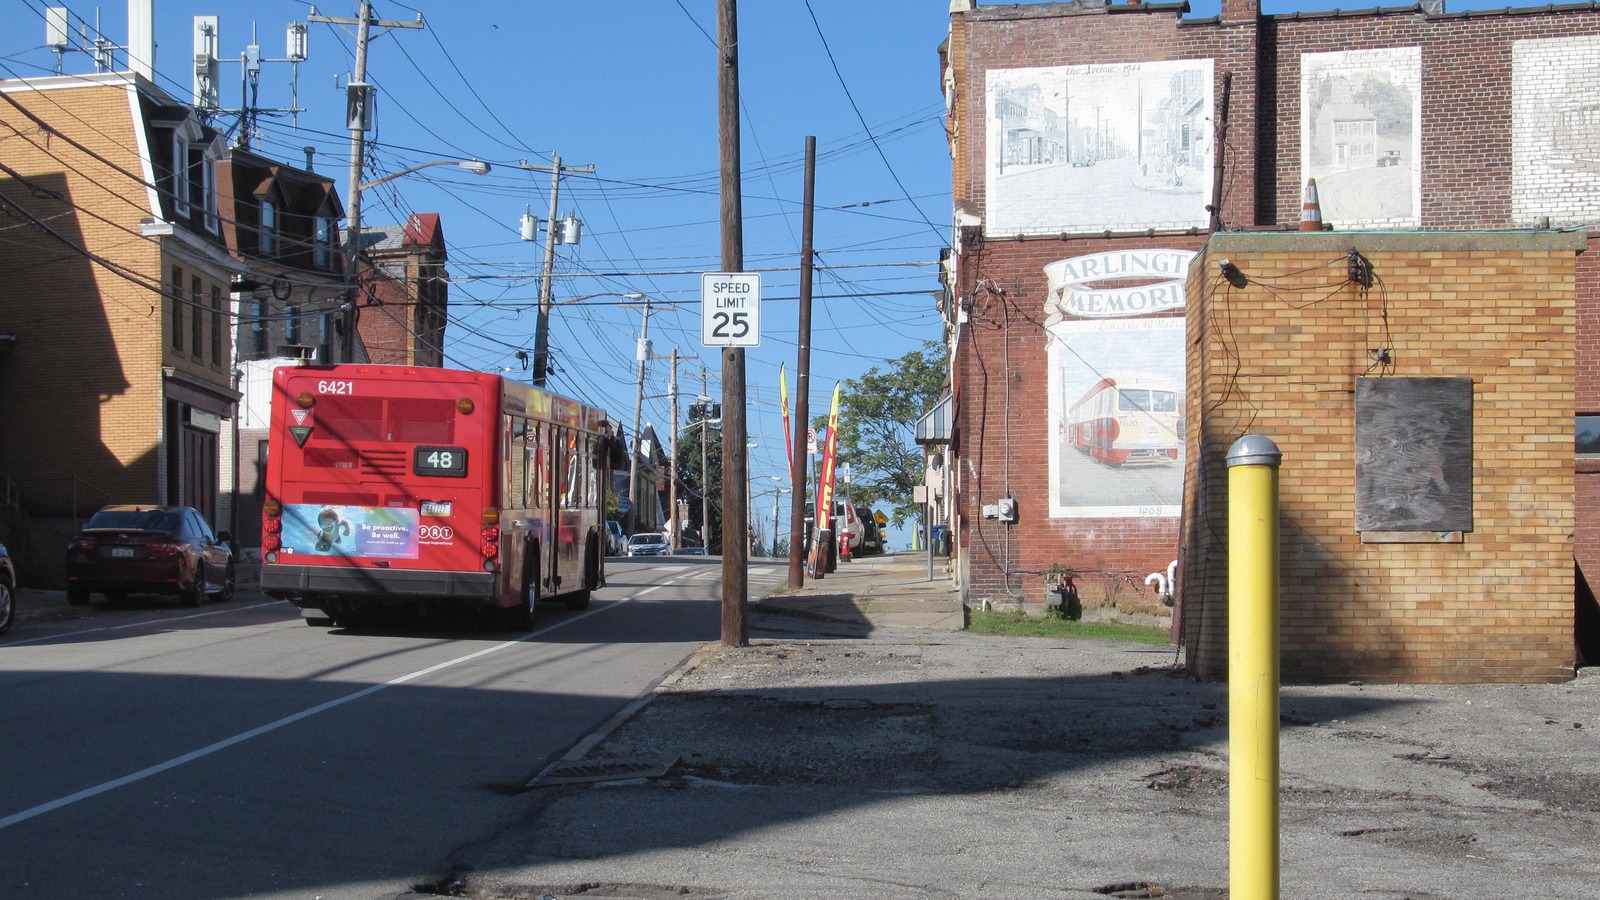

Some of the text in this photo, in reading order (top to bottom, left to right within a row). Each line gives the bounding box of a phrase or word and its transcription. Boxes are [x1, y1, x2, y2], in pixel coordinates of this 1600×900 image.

[1066, 67, 1080, 76] the
[1082, 65, 1114, 76] Avenue
[1063, 253, 1188, 282] ARLINGT
[713, 282, 750, 294] SPEED
[716, 297, 746, 308] LIMIT
[1064, 283, 1186, 313] MEMORI
[712, 311, 749, 338] 25
[318, 380, 353, 395] 6421
[427, 451, 453, 469] 48
[1139, 507, 1162, 516] 1968
